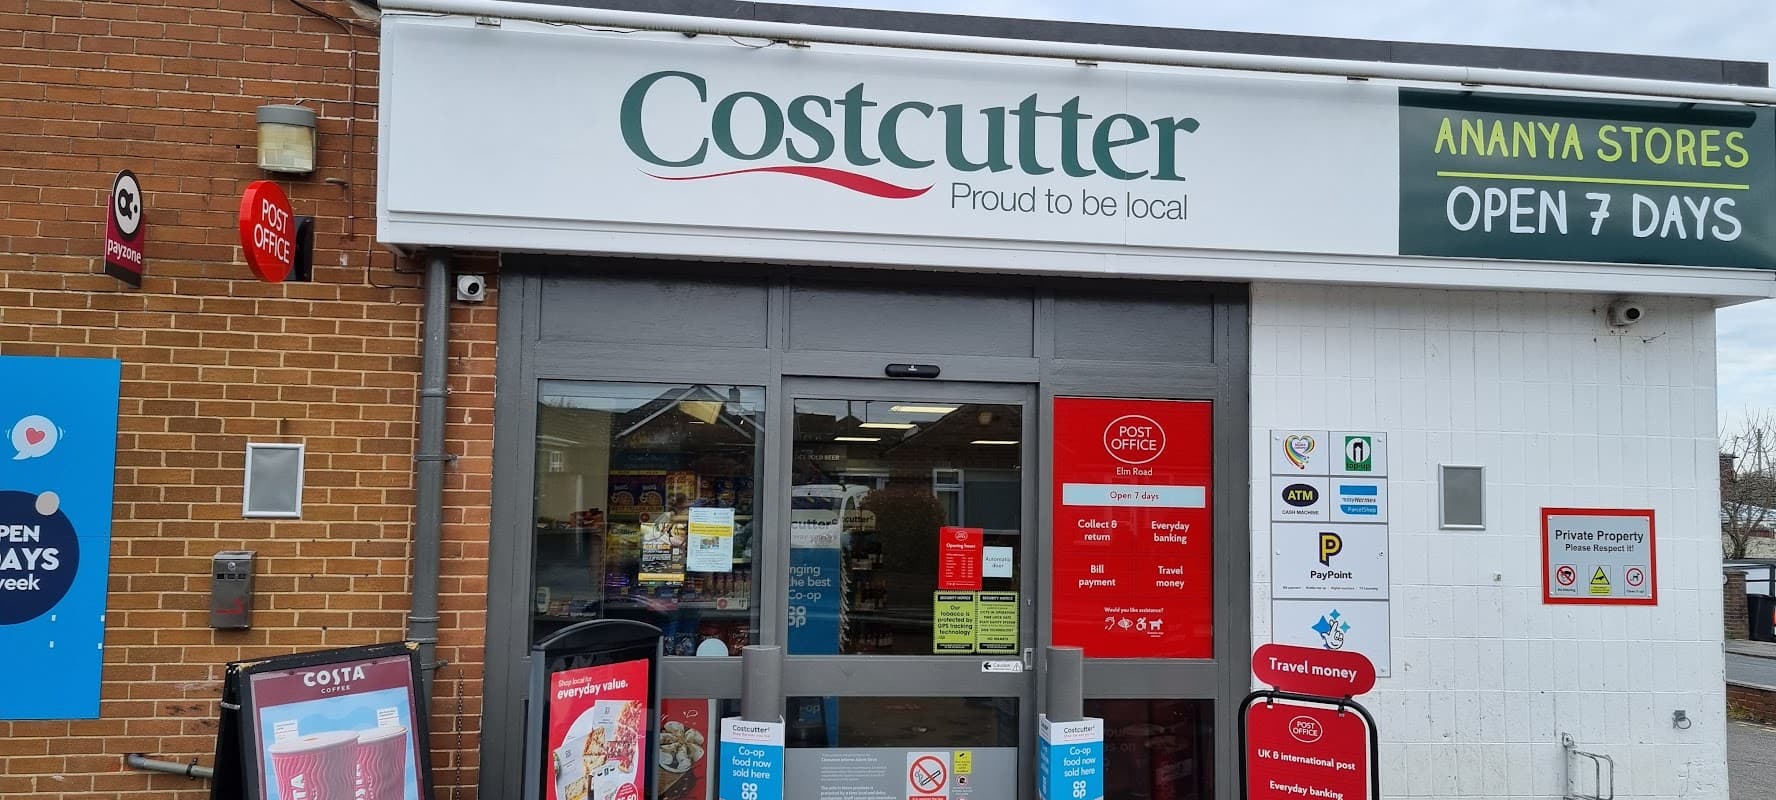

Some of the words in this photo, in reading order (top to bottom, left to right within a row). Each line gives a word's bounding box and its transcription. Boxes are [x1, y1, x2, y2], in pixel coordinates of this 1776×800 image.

[619, 70, 1201, 181] Costcutter
[1434, 117, 1583, 160] ANANYA
[1597, 125, 1750, 168] STORES
[951, 182, 1035, 213] Proud
[1045, 188, 1071, 215] to
[1081, 188, 1117, 217] be
[1126, 192, 1188, 220] local
[262, 198, 289, 235] POST
[1446, 185, 1568, 235] OPEN
[1585, 192, 1612, 236] 7
[1633, 193, 1742, 242] DAYS
[254, 223, 290, 264] OFFICE
[107, 239, 142, 265] payzone
[1119, 426, 1152, 438] POST
[1111, 438, 1157, 451] OFFICE
[1116, 467, 1131, 476] Elm
[1133, 467, 1153, 476] Road
[1110, 491, 1132, 501] Open
[1134, 492, 1139, 500] 7
[1141, 491, 1159, 502] days
[1287, 490, 1313, 500] ATM
[1078, 519, 1109, 529] Collect
[1111, 520, 1118, 529] &
[1151, 521, 1190, 533] Everyday
[0, 524, 40, 543] PEN
[1084, 533, 1111, 541] return
[1154, 533, 1187, 545] banking
[1555, 529, 1594, 541] Private
[1597, 530, 1644, 544] Property
[1565, 544, 1592, 552] Please
[1593, 544, 1625, 553] Respect
[0, 548, 60, 571] AYS
[789, 564, 821, 578] nging
[1090, 565, 1104, 574] Bill
[1158, 566, 1183, 575] Travel
[1310, 570, 1353, 581] PayPoint
[808, 577, 832, 587] best
[1078, 577, 1116, 589] payment
[1156, 579, 1185, 589] money
[1269, 657, 1308, 674] Travel
[1311, 666, 1358, 683] money
[303, 666, 365, 687] COSTA
[558, 679, 572, 688] Shop
[572, 676, 585, 685] local
[321, 684, 350, 694] COFFEE
[557, 682, 600, 699] everyday
[602, 678, 628, 692] value.
[732, 725, 769, 733] Costcutter
[1296, 720, 1316, 730] POST
[1292, 727, 1319, 737] OFFICE
[738, 746, 764, 758] Co-op
[1070, 746, 1091, 756] Co-op
[732, 756, 750, 766] food
[1064, 757, 1080, 766] food
[1258, 748, 1270, 758] UK
[1273, 751, 1278, 760] &
[1280, 752, 1334, 768] international
[1336, 761, 1356, 770] post
[732, 769, 749, 777] sold
[751, 770, 770, 779] here
[1064, 768, 1080, 777] sold
[1081, 767, 1095, 776] here
[742, 783, 757, 791] co
[1073, 780, 1086, 789] co
[1269, 780, 1308, 797] Everyday
[1309, 786, 1344, 800] banking
[1073, 789, 1086, 799] op
